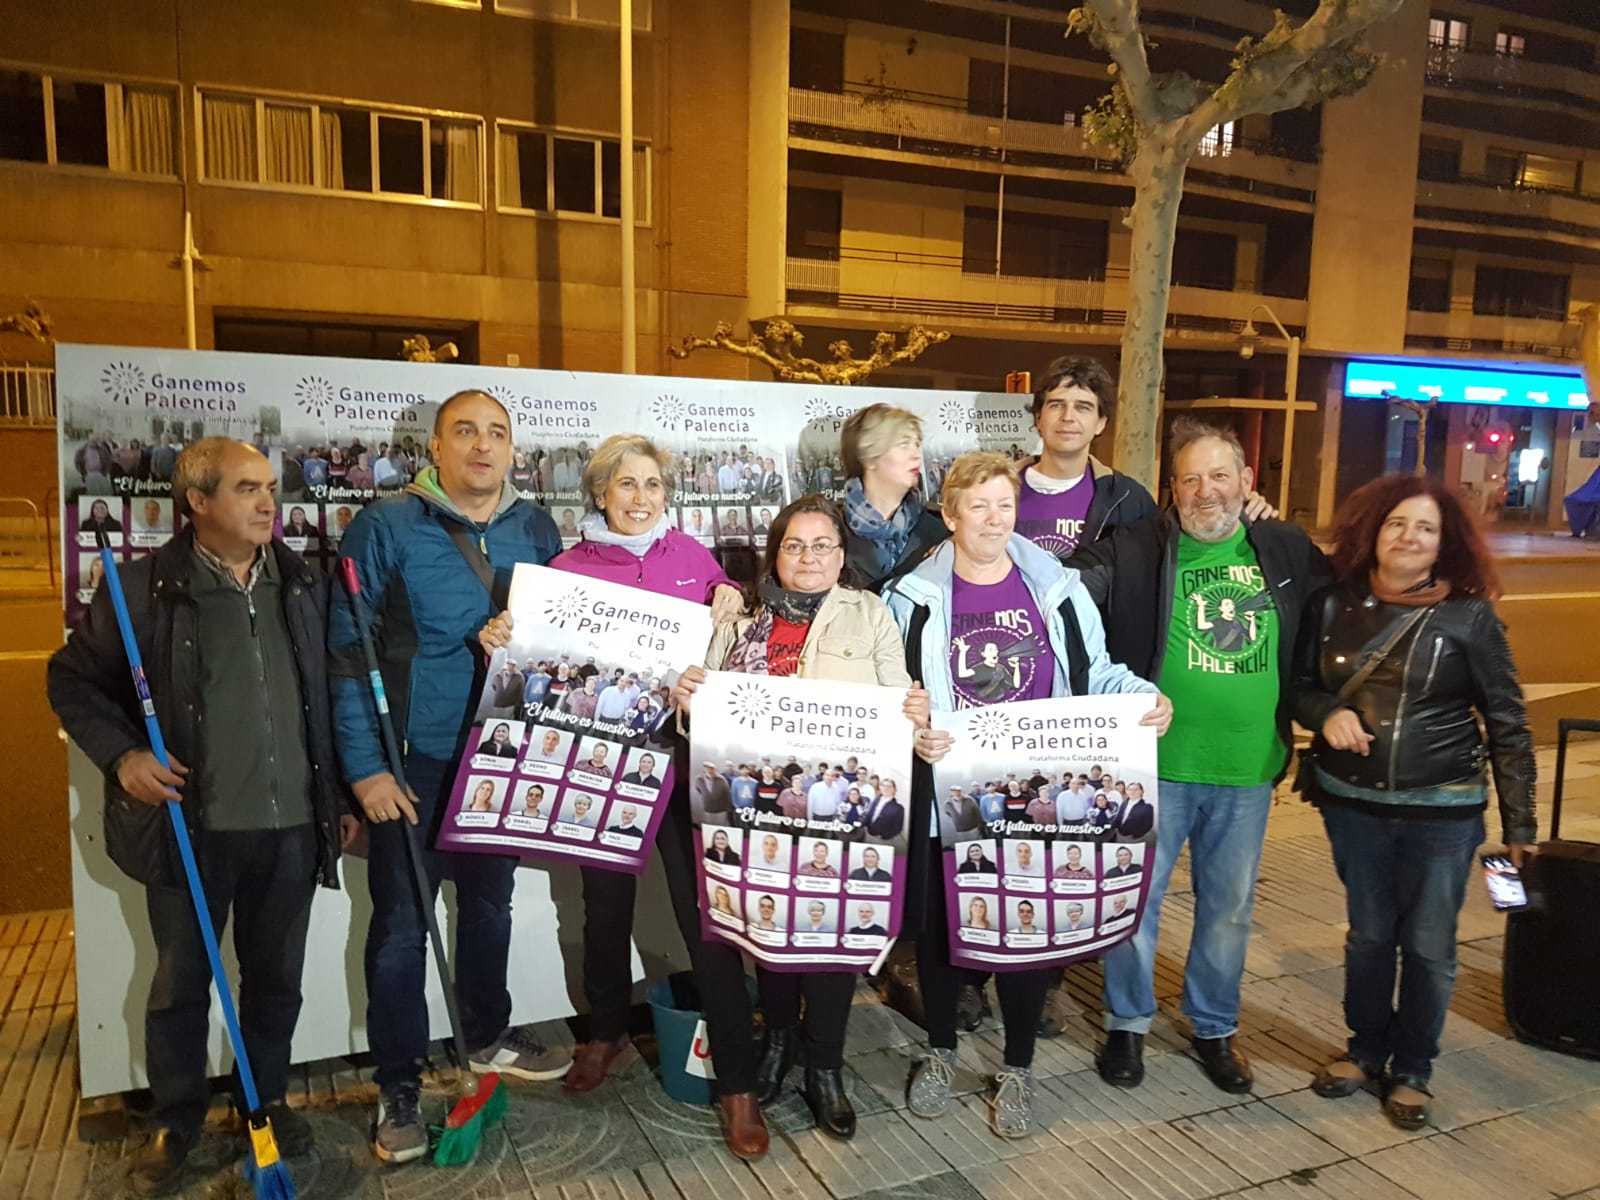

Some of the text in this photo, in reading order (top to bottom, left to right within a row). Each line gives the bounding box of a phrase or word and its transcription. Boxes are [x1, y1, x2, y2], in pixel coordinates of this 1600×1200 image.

[152, 374, 247, 393] Ganemos
[144, 392, 237, 412] Palencia
[339, 386, 425, 406] Ganemos
[521, 395, 598, 412] Ganemos
[334, 404, 417, 422] Palencia
[687, 403, 756, 418] Ganemos
[967, 407, 1023, 419] Ganemos
[517, 411, 591, 428] Palencia
[684, 419, 750, 433] Palencia
[965, 421, 1019, 433] Palencia
[134, 477, 172, 495] futuro
[328, 486, 361, 500] futuro
[363, 488, 374, 498] es
[684, 492, 710, 504] futuro
[711, 493, 720, 501] es
[1181, 565, 1265, 599] GANEMOS
[592, 600, 681, 634] Ganemos
[577, 617, 666, 651] Palcia
[1188, 638, 1268, 674] PALENCIA
[541, 705, 579, 724] futuro
[579, 715, 592, 728] es
[778, 696, 879, 720] Ganemos
[770, 715, 867, 739] Palencia
[1017, 716, 1118, 731] Ganemos
[1012, 733, 1108, 750] Palencia
[754, 811, 793, 826] futuro
[793, 818, 806, 828] es
[1006, 820, 1044, 835] futuro
[1044, 824, 1058, 833] es
